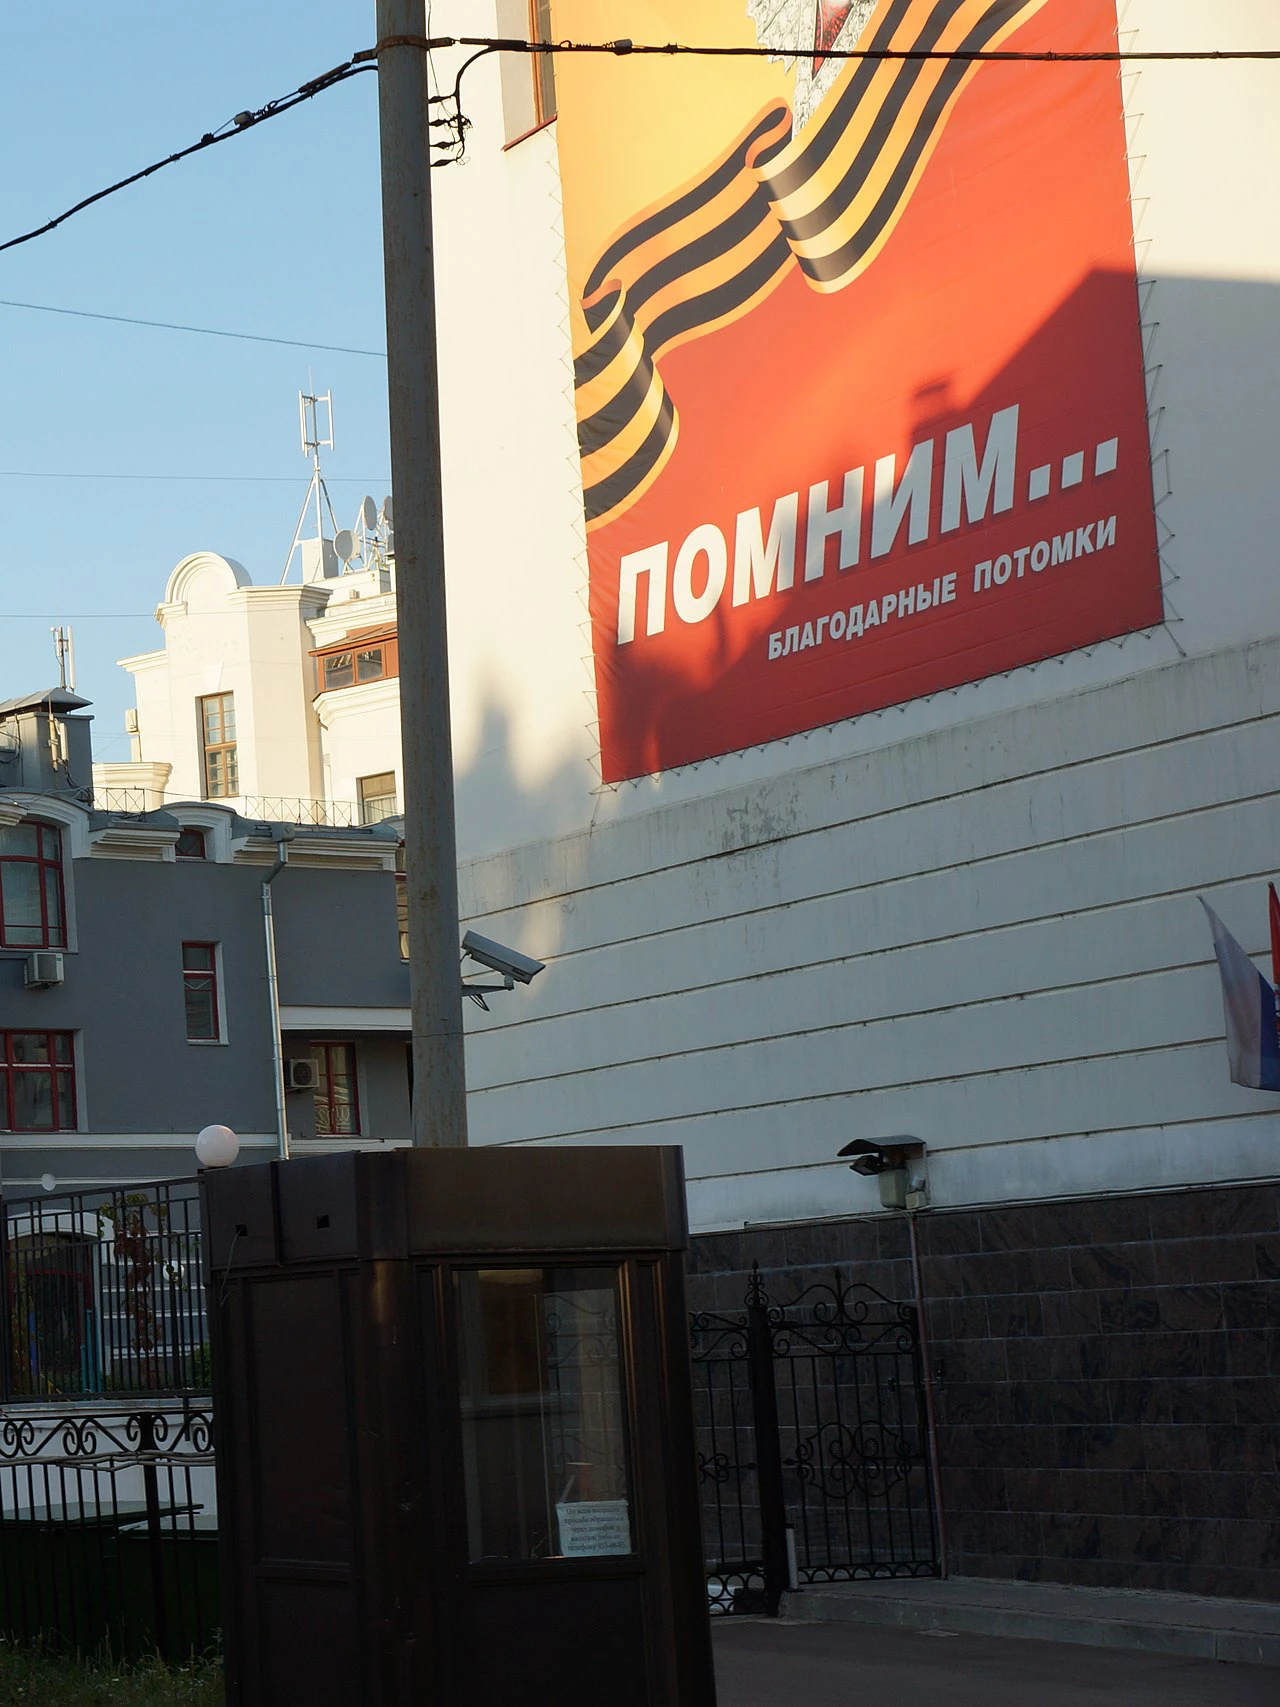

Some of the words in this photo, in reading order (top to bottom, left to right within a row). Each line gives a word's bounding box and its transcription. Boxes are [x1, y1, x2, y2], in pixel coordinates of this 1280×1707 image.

[616, 403, 1120, 646] ПОМНИМ...
[767, 571, 958, 661] БЛАГОДАРНЫЕ
[973, 515, 1117, 594] ПОТОМКИ
